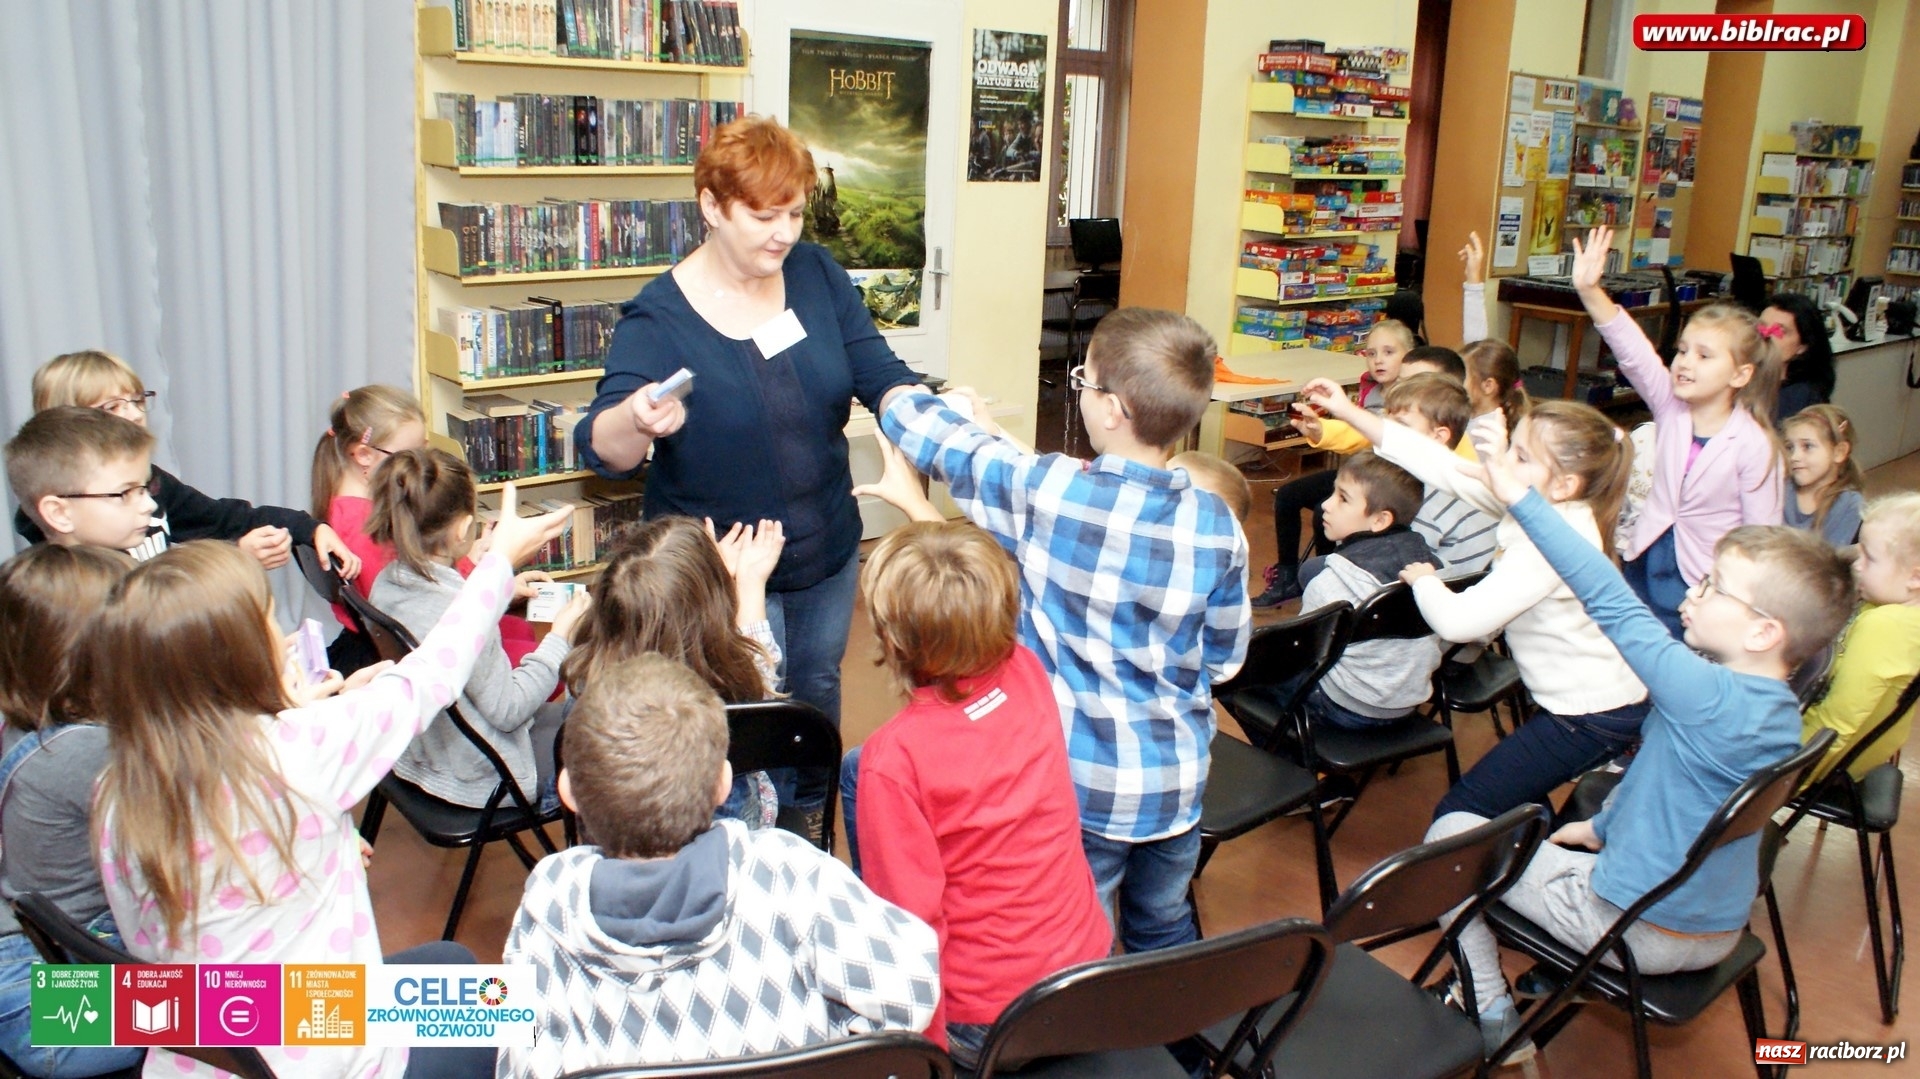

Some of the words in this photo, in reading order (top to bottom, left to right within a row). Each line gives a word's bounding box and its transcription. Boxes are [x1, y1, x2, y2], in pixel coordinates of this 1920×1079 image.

[977, 59, 1039, 77] ODWAGA
[829, 68, 896, 100] HOBBIT
[977, 77, 1013, 87] RATUJE
